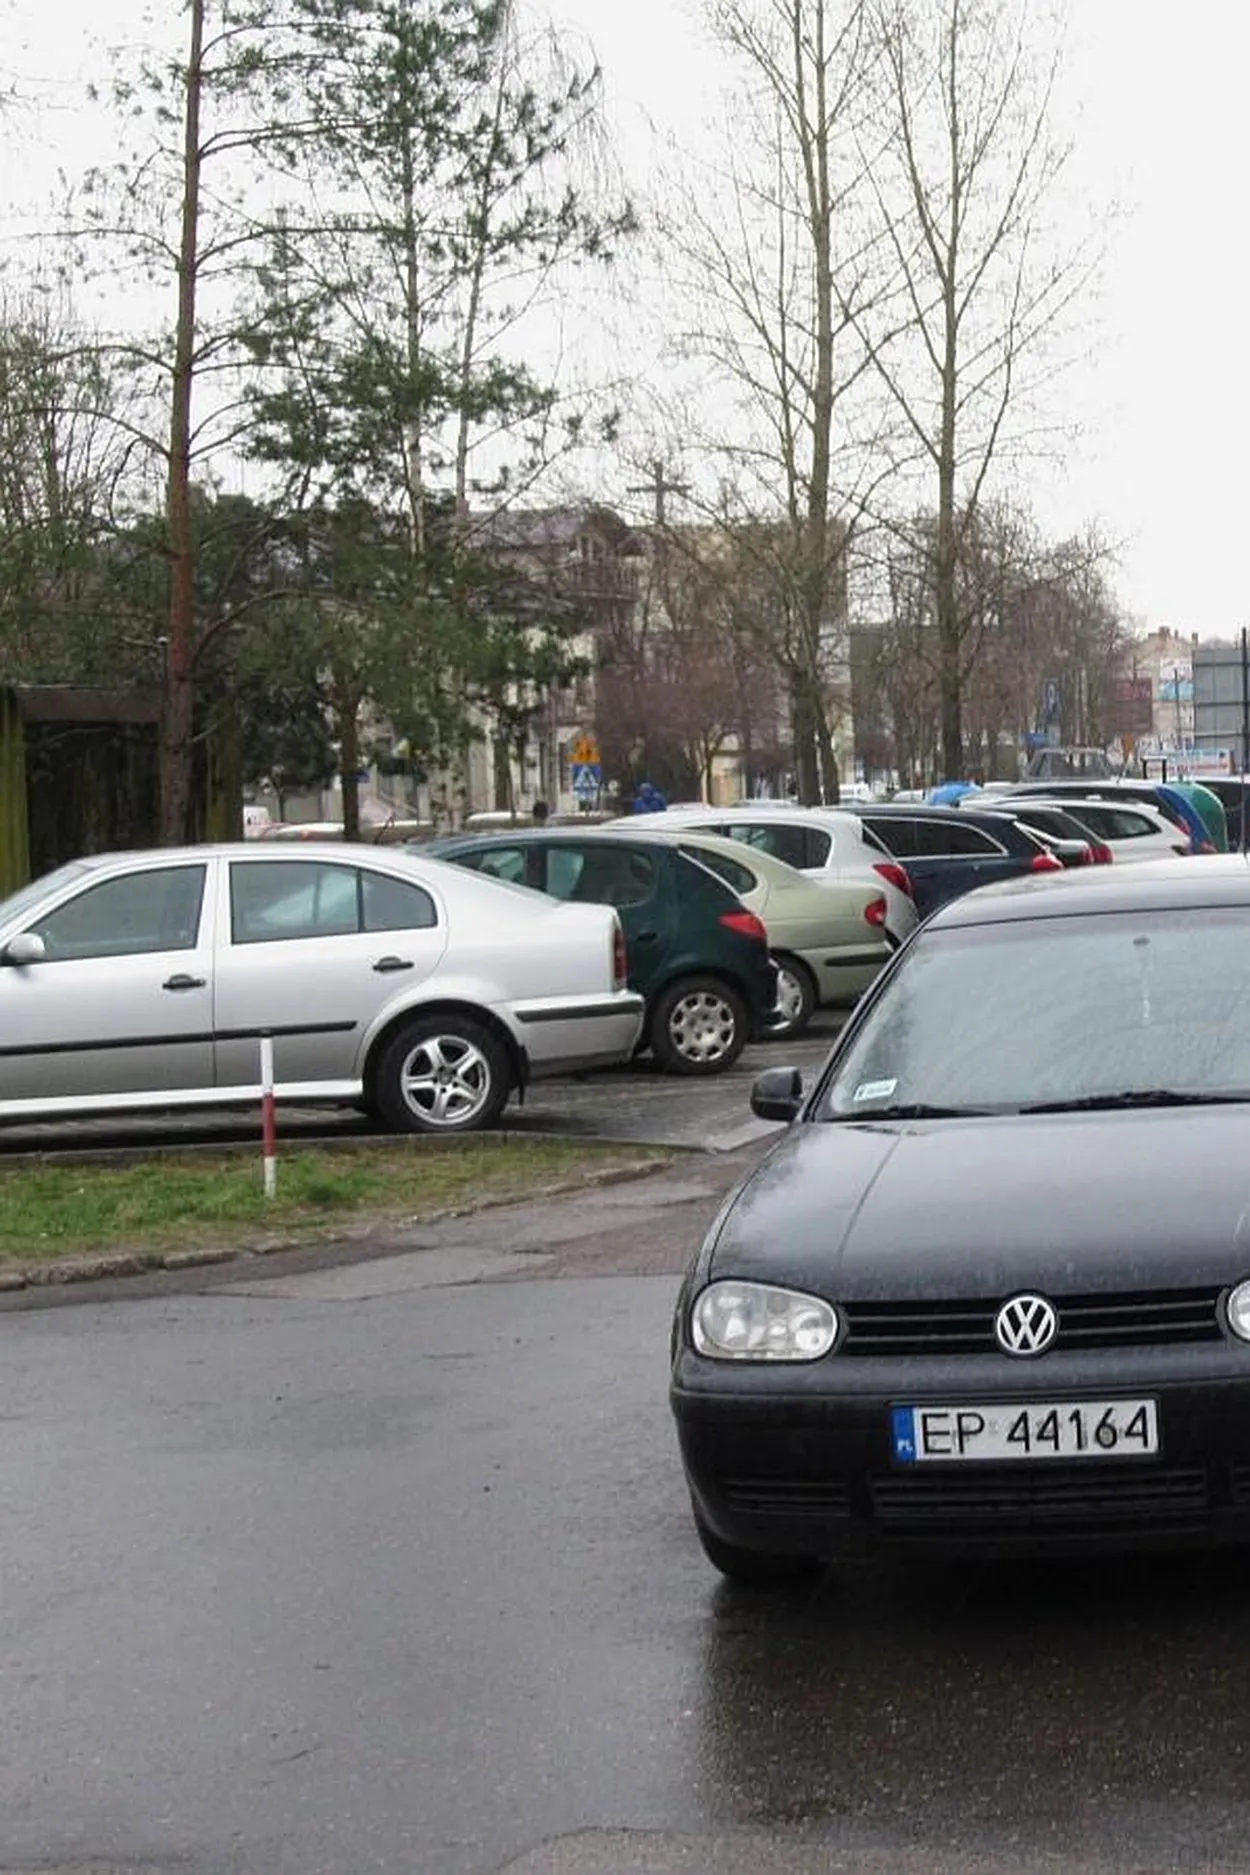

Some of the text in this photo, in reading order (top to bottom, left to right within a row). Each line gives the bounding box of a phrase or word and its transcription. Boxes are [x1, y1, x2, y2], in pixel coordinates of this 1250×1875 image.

[897, 1438, 913, 1452] PL
[921, 1405, 1149, 1454] EP 44164
